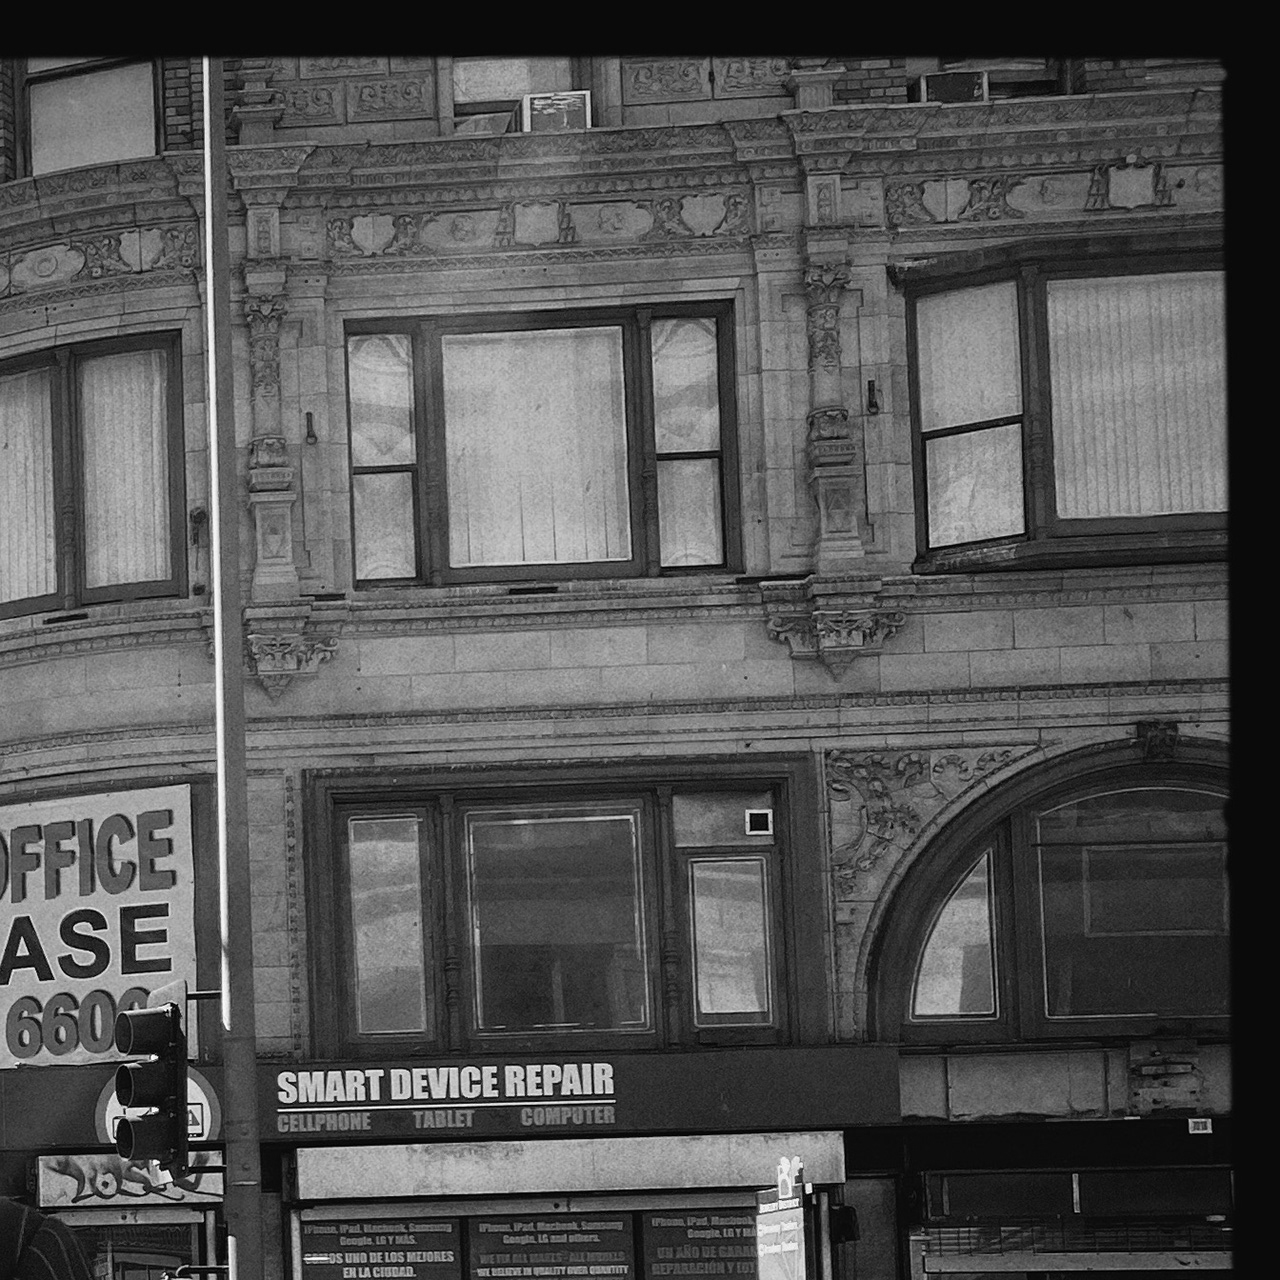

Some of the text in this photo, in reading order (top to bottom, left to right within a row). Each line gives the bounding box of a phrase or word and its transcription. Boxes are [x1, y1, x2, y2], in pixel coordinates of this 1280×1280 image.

[277, 1062, 615, 1104] SMART DEVICE REPAIR
[277, 1106, 616, 1133] CELLPHONE TABLET COMPUTER
[345, 1251, 454, 1264] UNO DE LOS MEJORES
[343, 1266, 417, 1278] EN LA CIUDAD.
